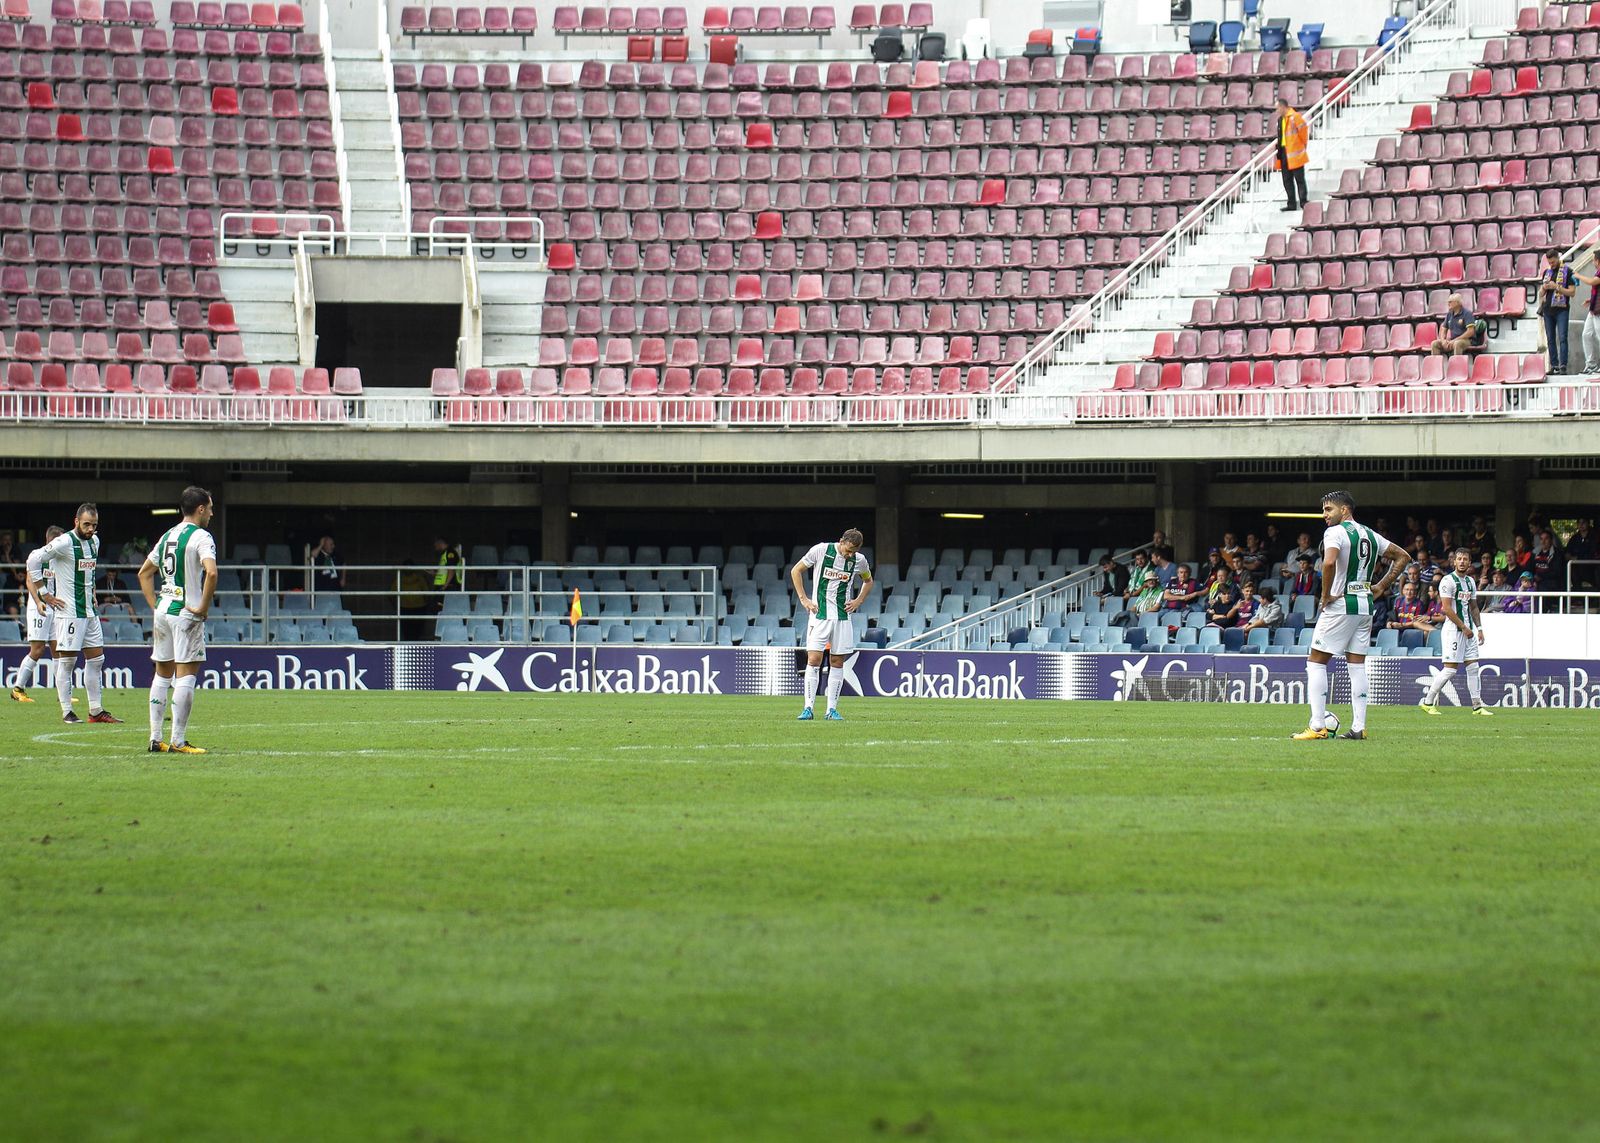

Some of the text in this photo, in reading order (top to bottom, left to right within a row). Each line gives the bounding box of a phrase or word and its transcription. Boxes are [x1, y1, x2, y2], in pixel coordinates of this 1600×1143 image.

[164, 541, 178, 576] 5
[1359, 538, 1371, 570] 9
[33, 618, 43, 629] 18
[68, 622, 75, 635] 6
[1452, 641, 1458, 651] 3
[196, 653, 369, 691] aixaBank
[521, 651, 723, 694] CaixaBank
[872, 655, 1026, 700] CaixaBank
[1161, 659, 1306, 705] CaixaBan
